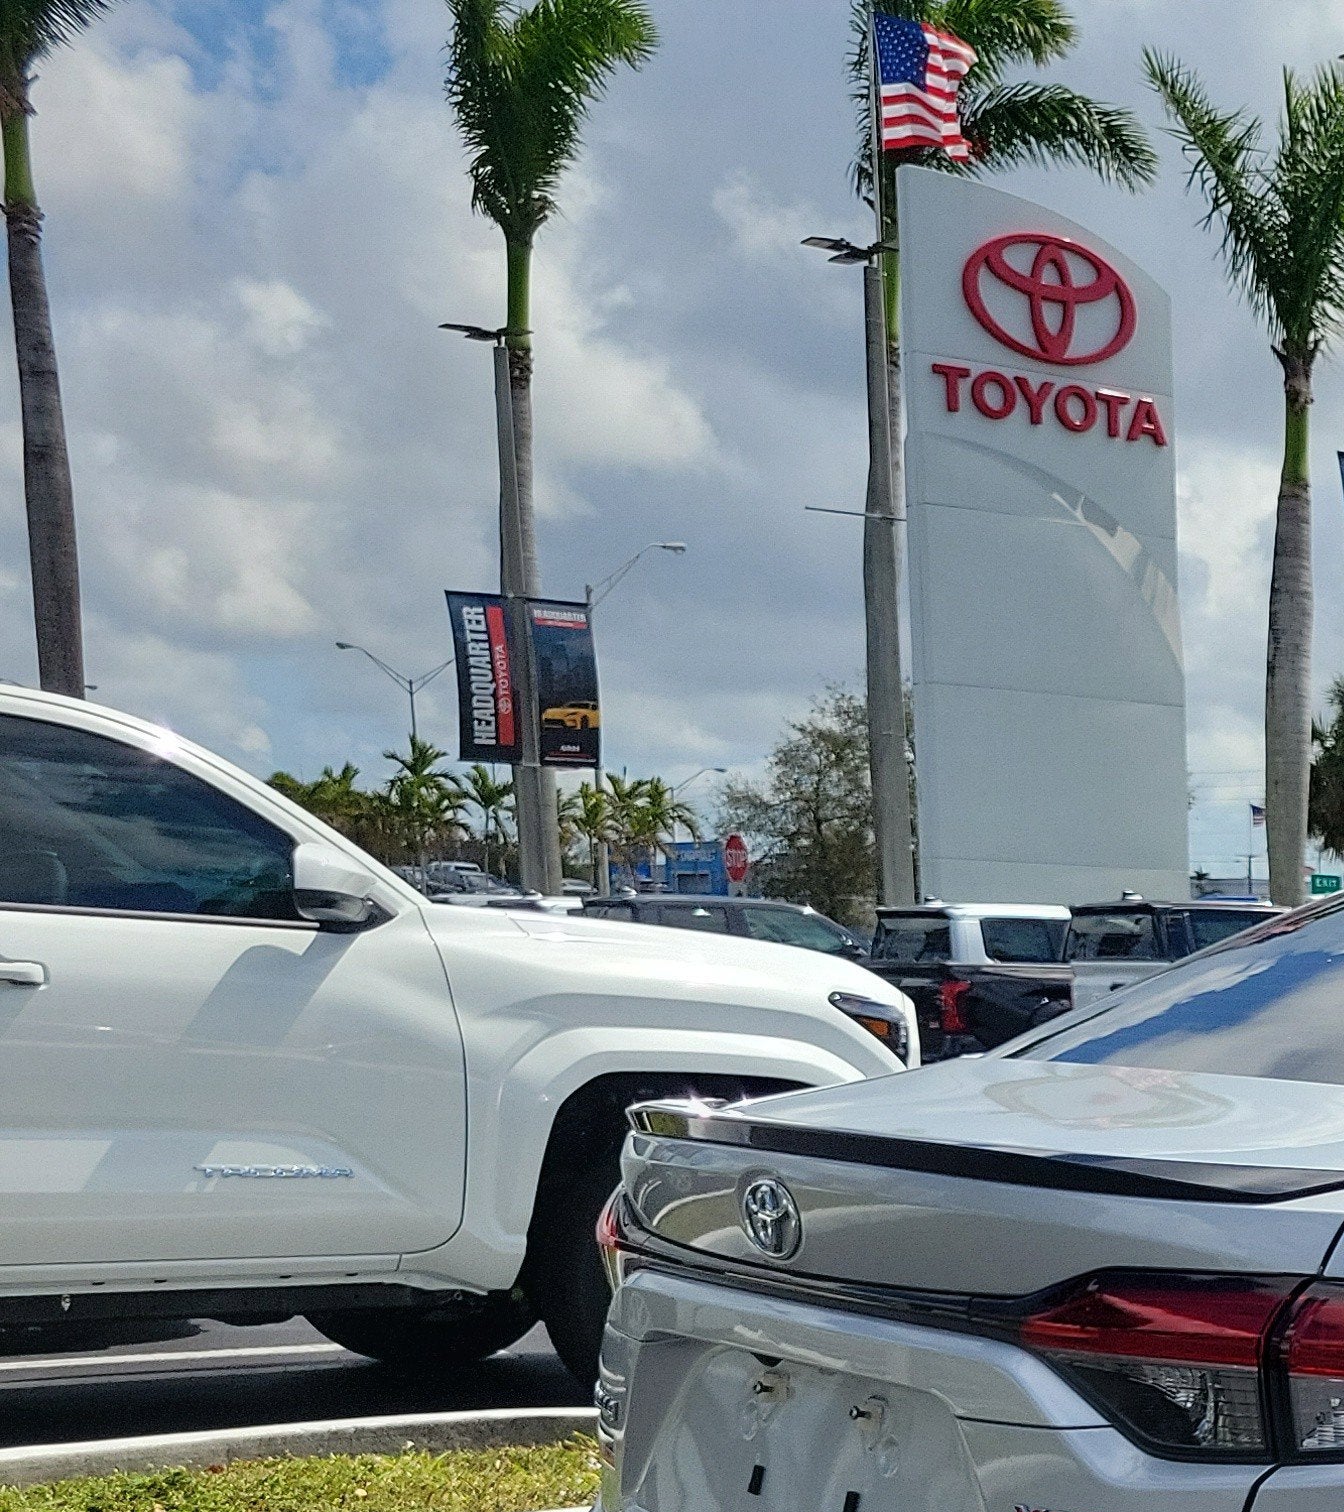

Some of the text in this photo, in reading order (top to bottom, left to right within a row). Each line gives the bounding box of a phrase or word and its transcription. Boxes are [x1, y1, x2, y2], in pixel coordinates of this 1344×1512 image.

[931, 363, 1167, 447] TOYOTA
[462, 606, 497, 746] HEADQUARTER
[496, 644, 509, 694] TOYOTA
[726, 848, 748, 868] STOP
